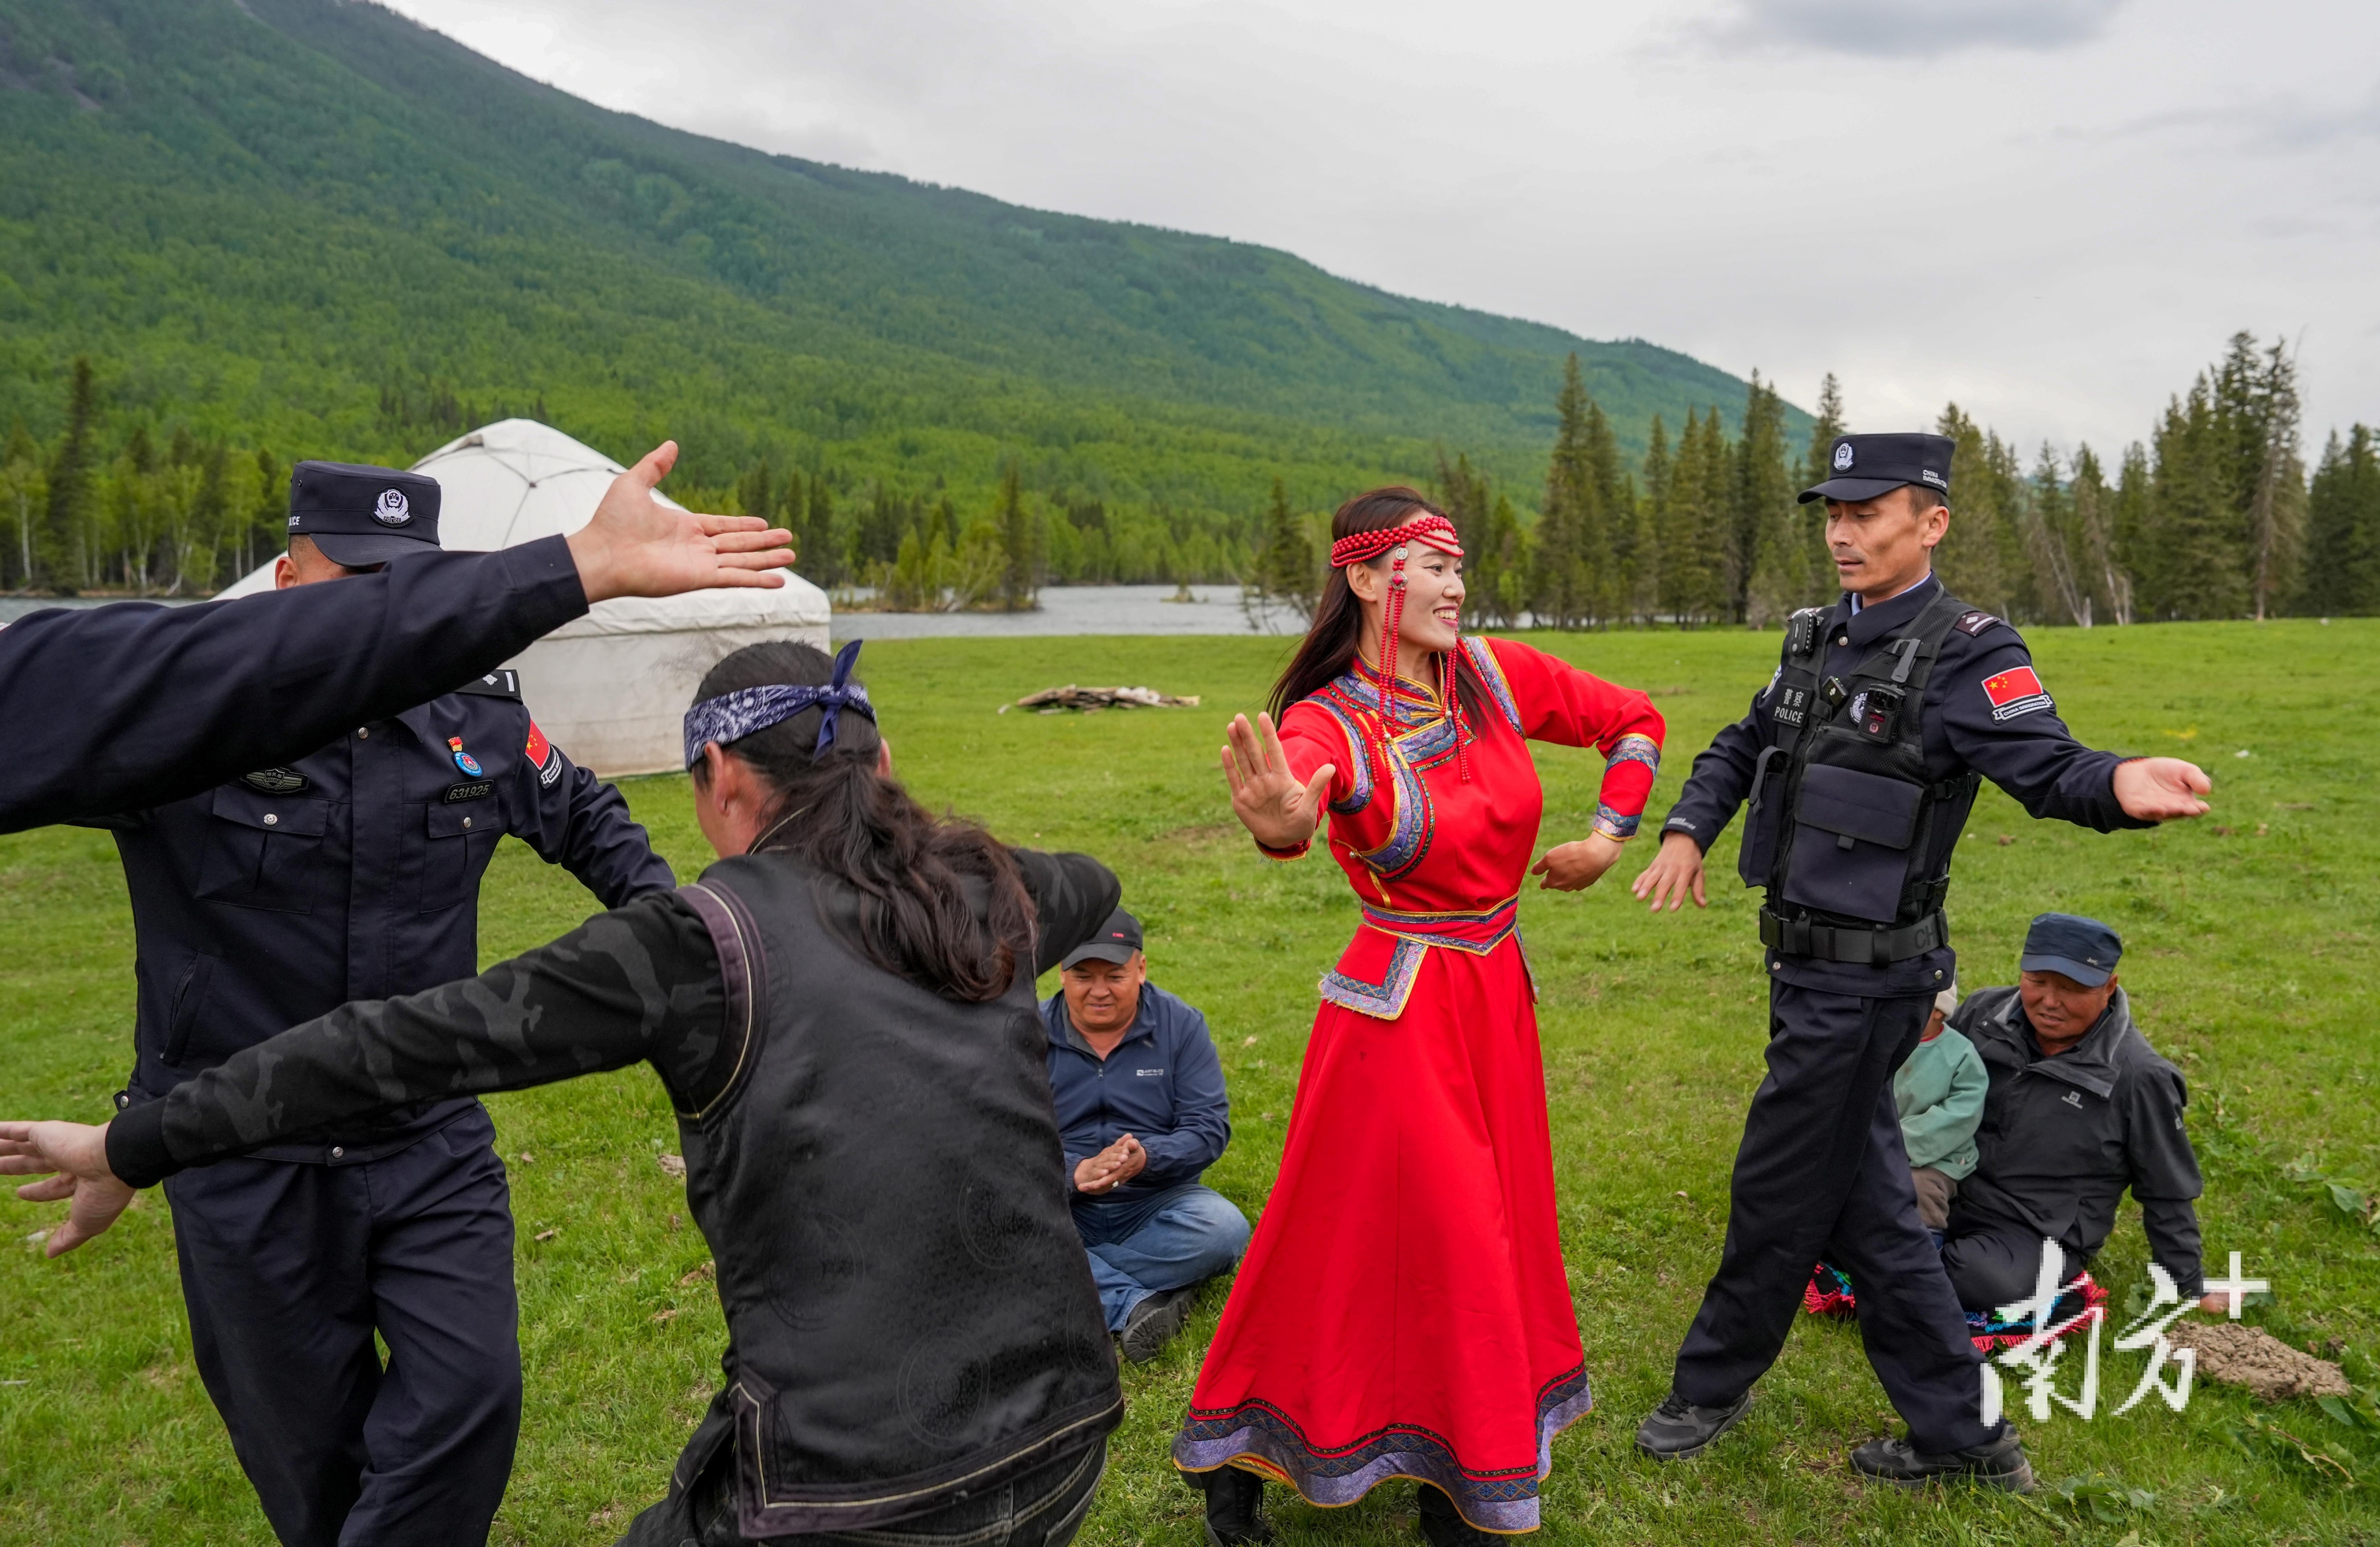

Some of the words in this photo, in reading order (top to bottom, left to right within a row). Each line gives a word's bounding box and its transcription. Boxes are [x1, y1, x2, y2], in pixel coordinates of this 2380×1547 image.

[1784, 688, 1804, 707] 警察
[1774, 706, 1803, 723] POLICE
[2003, 707, 2019, 716] CHINA
[2019, 701, 2046, 710] IMMIGRATION
[449, 784, 490, 800] 631925
